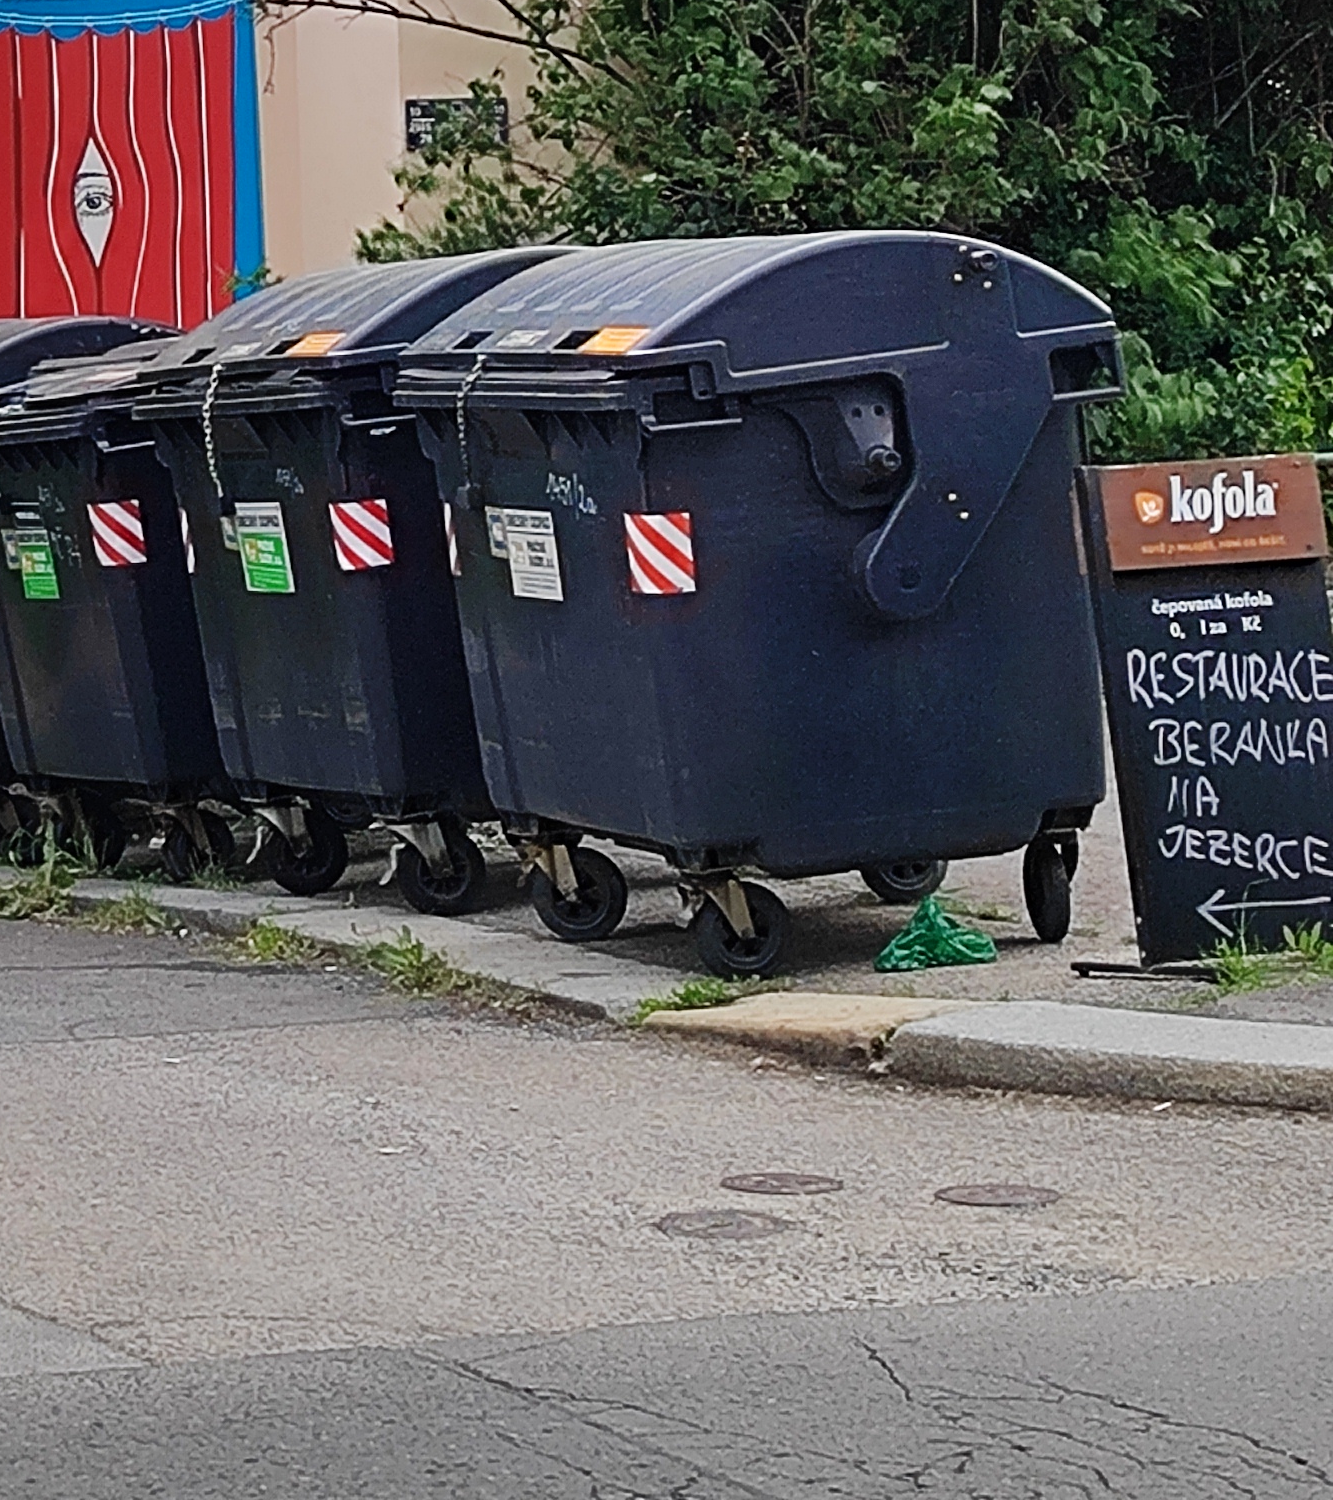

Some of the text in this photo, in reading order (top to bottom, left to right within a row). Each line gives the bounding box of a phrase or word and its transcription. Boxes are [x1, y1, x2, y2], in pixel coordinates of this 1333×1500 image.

[1169, 470, 1278, 534] kofola
[1151, 591, 1274, 617] čepovaná kofola
[1209, 620, 1228, 636] za
[1241, 615, 1263, 632] Kč
[1127, 649, 1333, 709] RESTAURACE
[1158, 824, 1333, 880] JEZERCE
